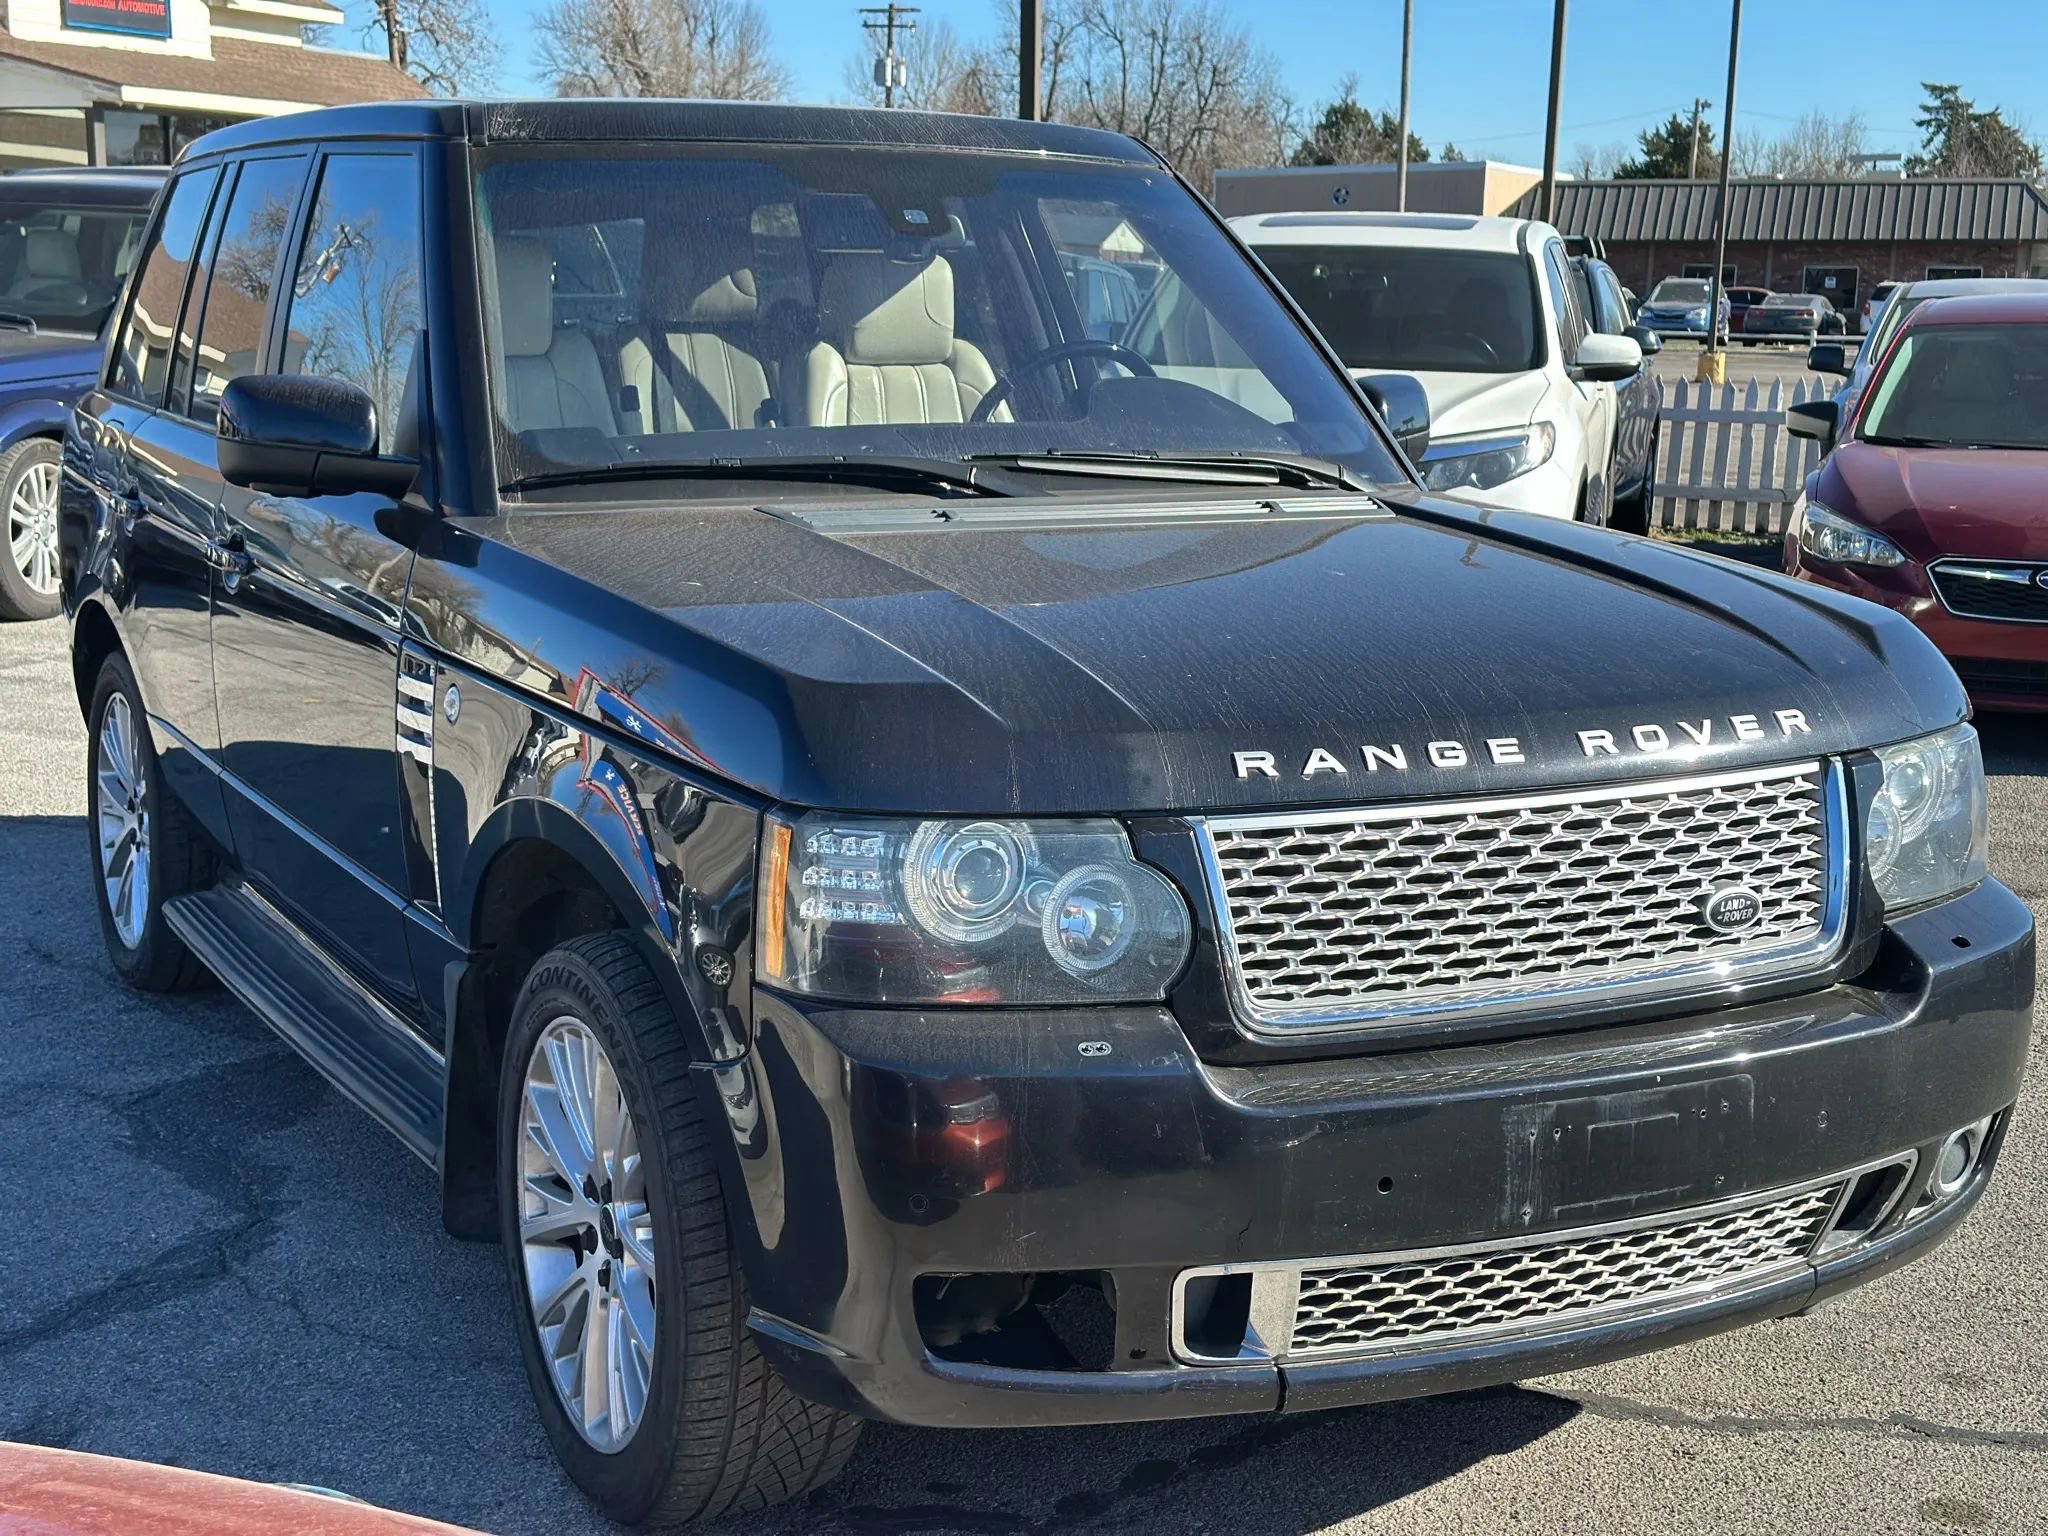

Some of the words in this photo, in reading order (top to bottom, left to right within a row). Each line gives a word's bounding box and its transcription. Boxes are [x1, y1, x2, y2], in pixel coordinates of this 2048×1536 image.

[118, 0, 165, 15] AUTOMOTIVE
[1233, 738, 1525, 779] RANGE
[1577, 708, 1811, 759] ROVER
[529, 966, 648, 1137] CONTINENTAL
